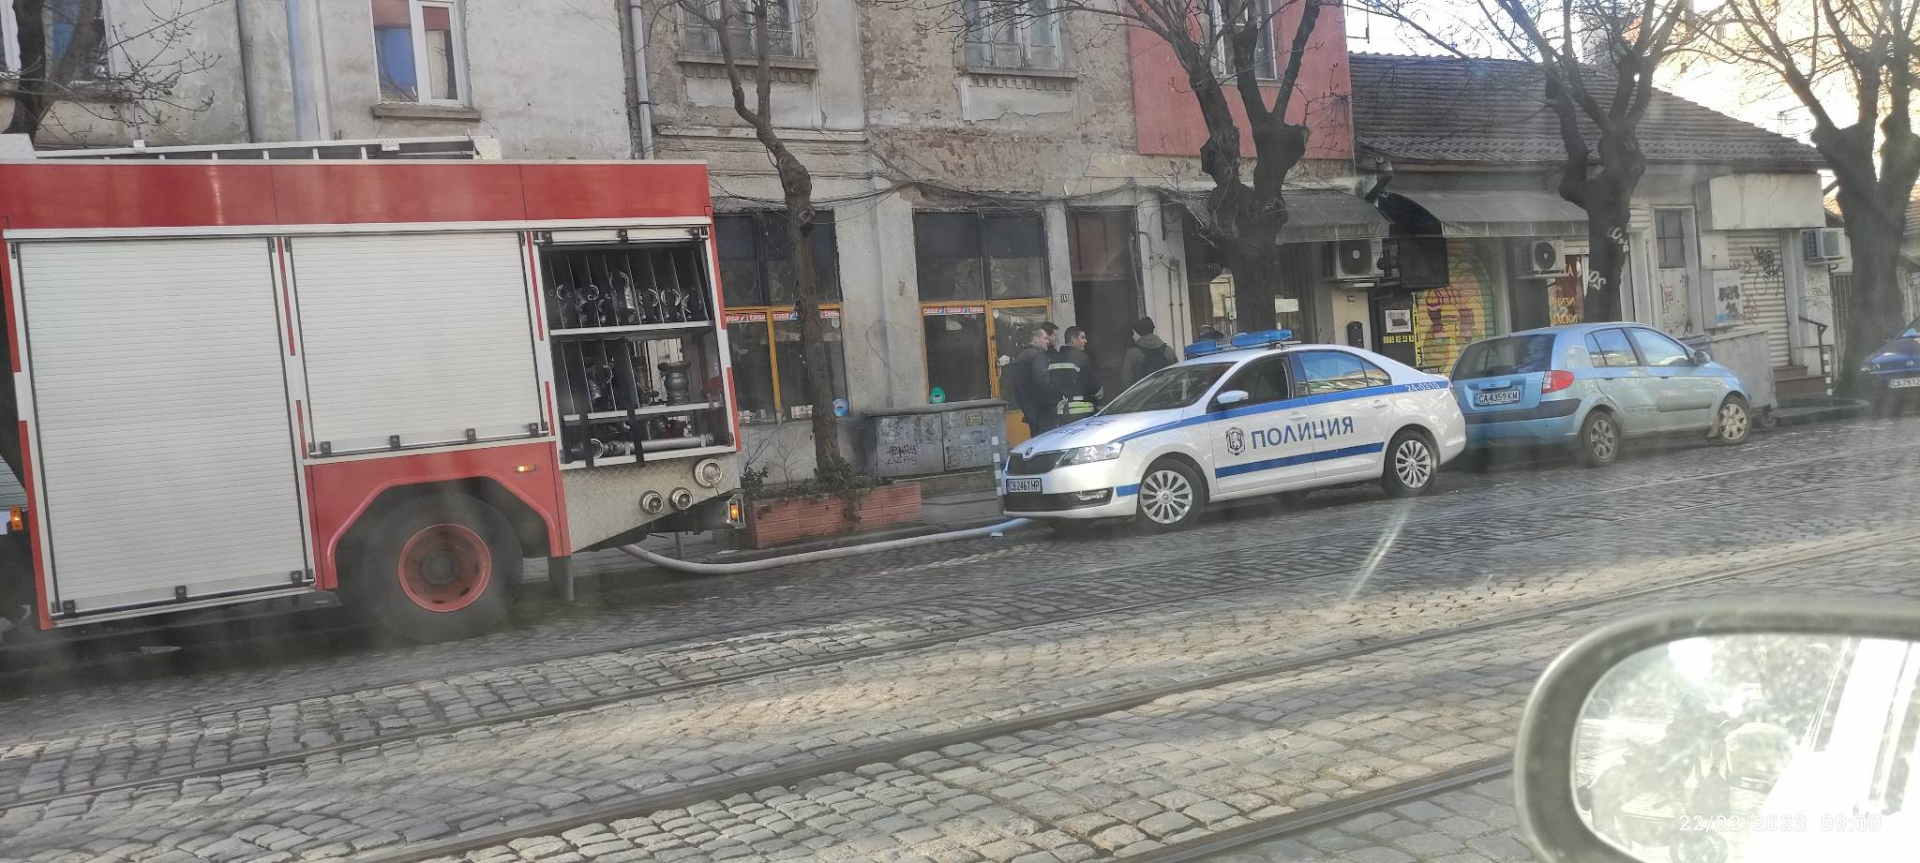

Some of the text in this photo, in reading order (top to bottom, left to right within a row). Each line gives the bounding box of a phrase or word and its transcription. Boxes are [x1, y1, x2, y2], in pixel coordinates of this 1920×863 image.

[1405, 381, 1440, 392] 24-0310
[1478, 395, 1488, 404] CA
[1489, 393, 1507, 402] 4359
[1251, 416, 1354, 449] ПОЛИЦИЯ
